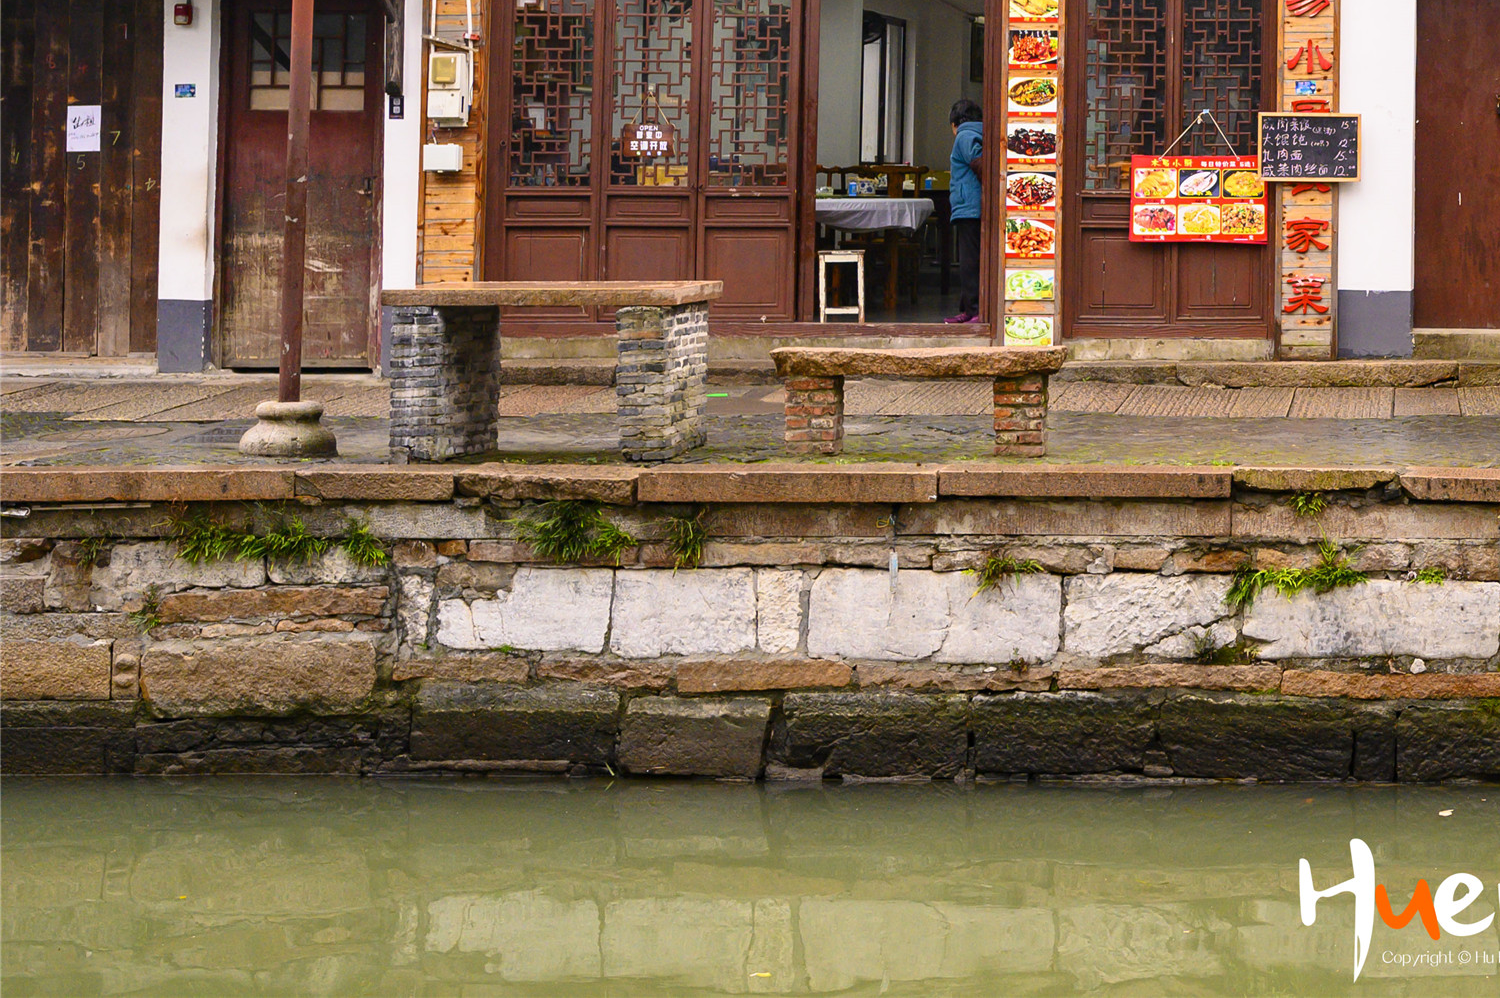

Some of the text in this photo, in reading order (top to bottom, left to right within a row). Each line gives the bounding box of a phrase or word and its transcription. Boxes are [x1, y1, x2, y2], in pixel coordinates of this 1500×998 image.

[630, 140, 668, 151] 空调开放
[75, 154, 87, 170] 5
